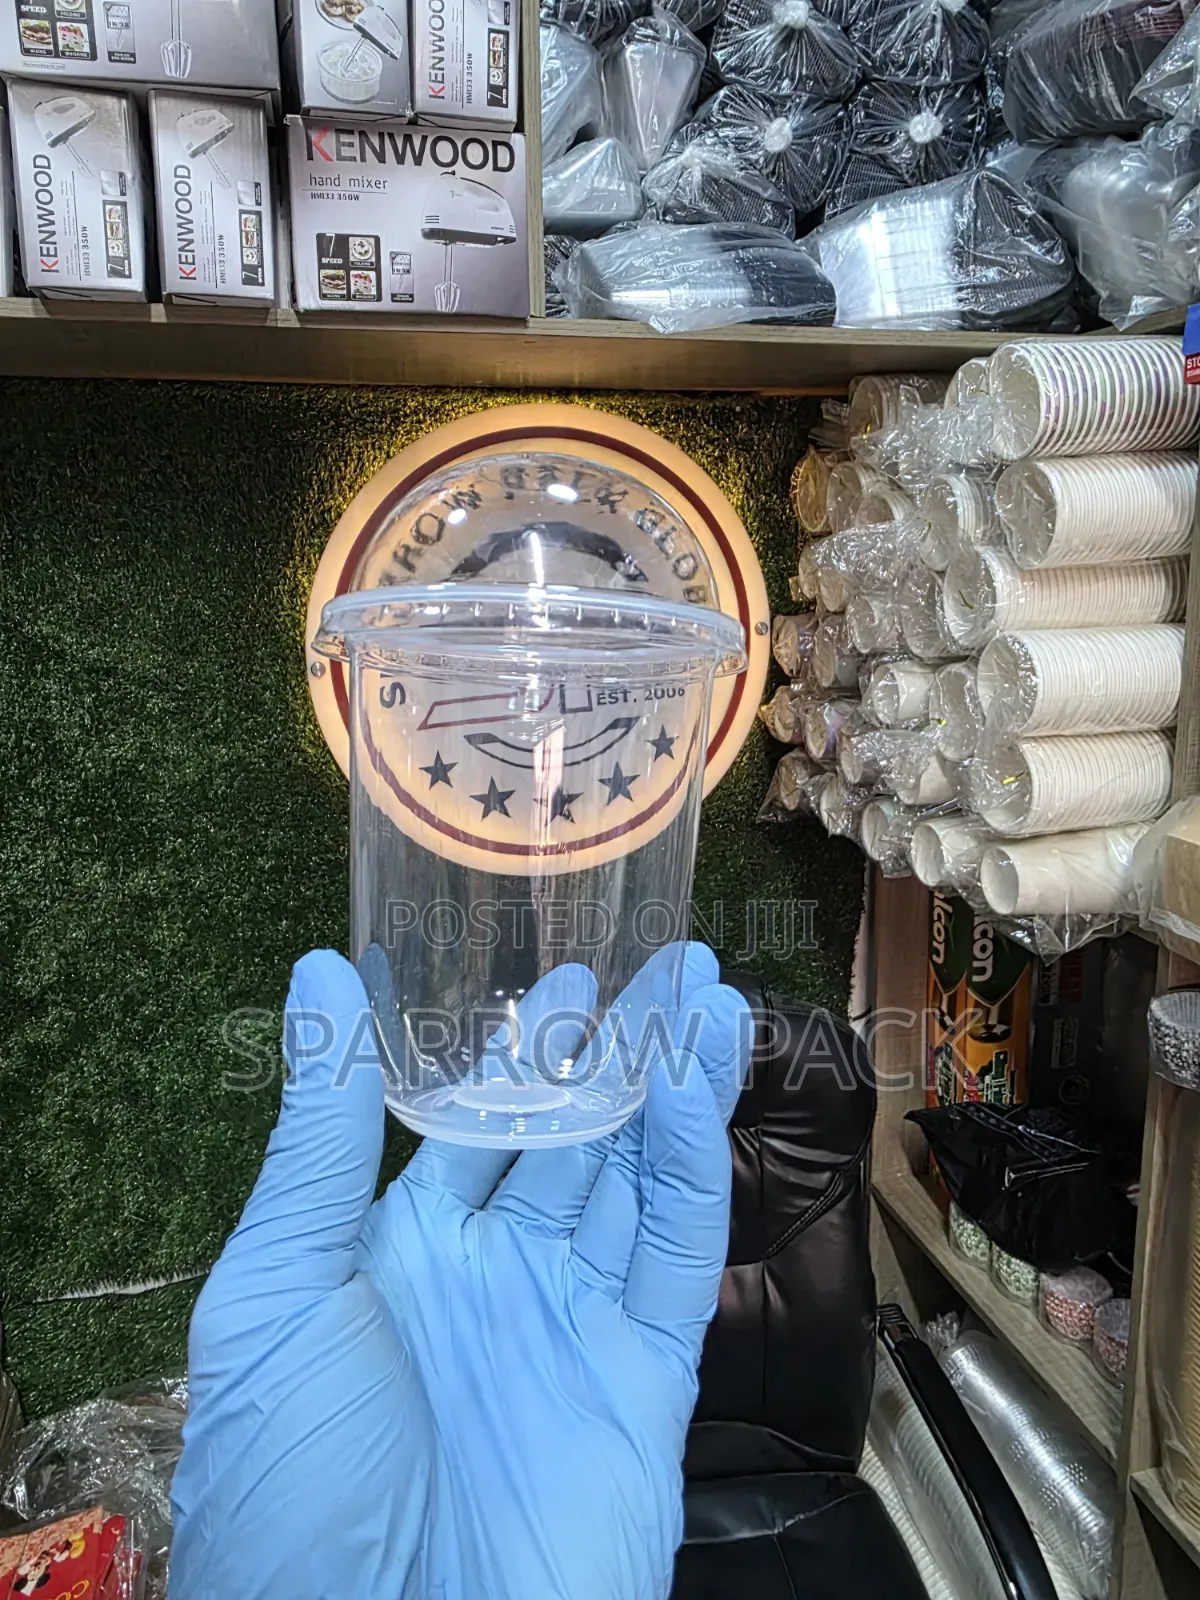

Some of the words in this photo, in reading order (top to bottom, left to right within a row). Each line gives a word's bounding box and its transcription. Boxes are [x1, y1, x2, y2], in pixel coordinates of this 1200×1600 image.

[20, 4, 47, 14] SPEED
[487, 91, 502, 100] 7
[306, 127, 516, 173] KENWOOD
[309, 173, 341, 188] hand
[348, 175, 388, 189] mixer
[336, 193, 360, 201] 350W
[32, 154, 60, 273] KENWOOD
[173, 164, 197, 281] KENWOOD
[80, 225, 90, 249] 350W
[217, 234, 225, 257] 350W
[325, 233, 336, 258] 7
[107, 262, 125, 272] 7
[321, 257, 343, 265] SPEED
[242, 270, 258, 279] 7
[597, 689, 638, 706] EST.
[643, 686, 686, 702] 2006
